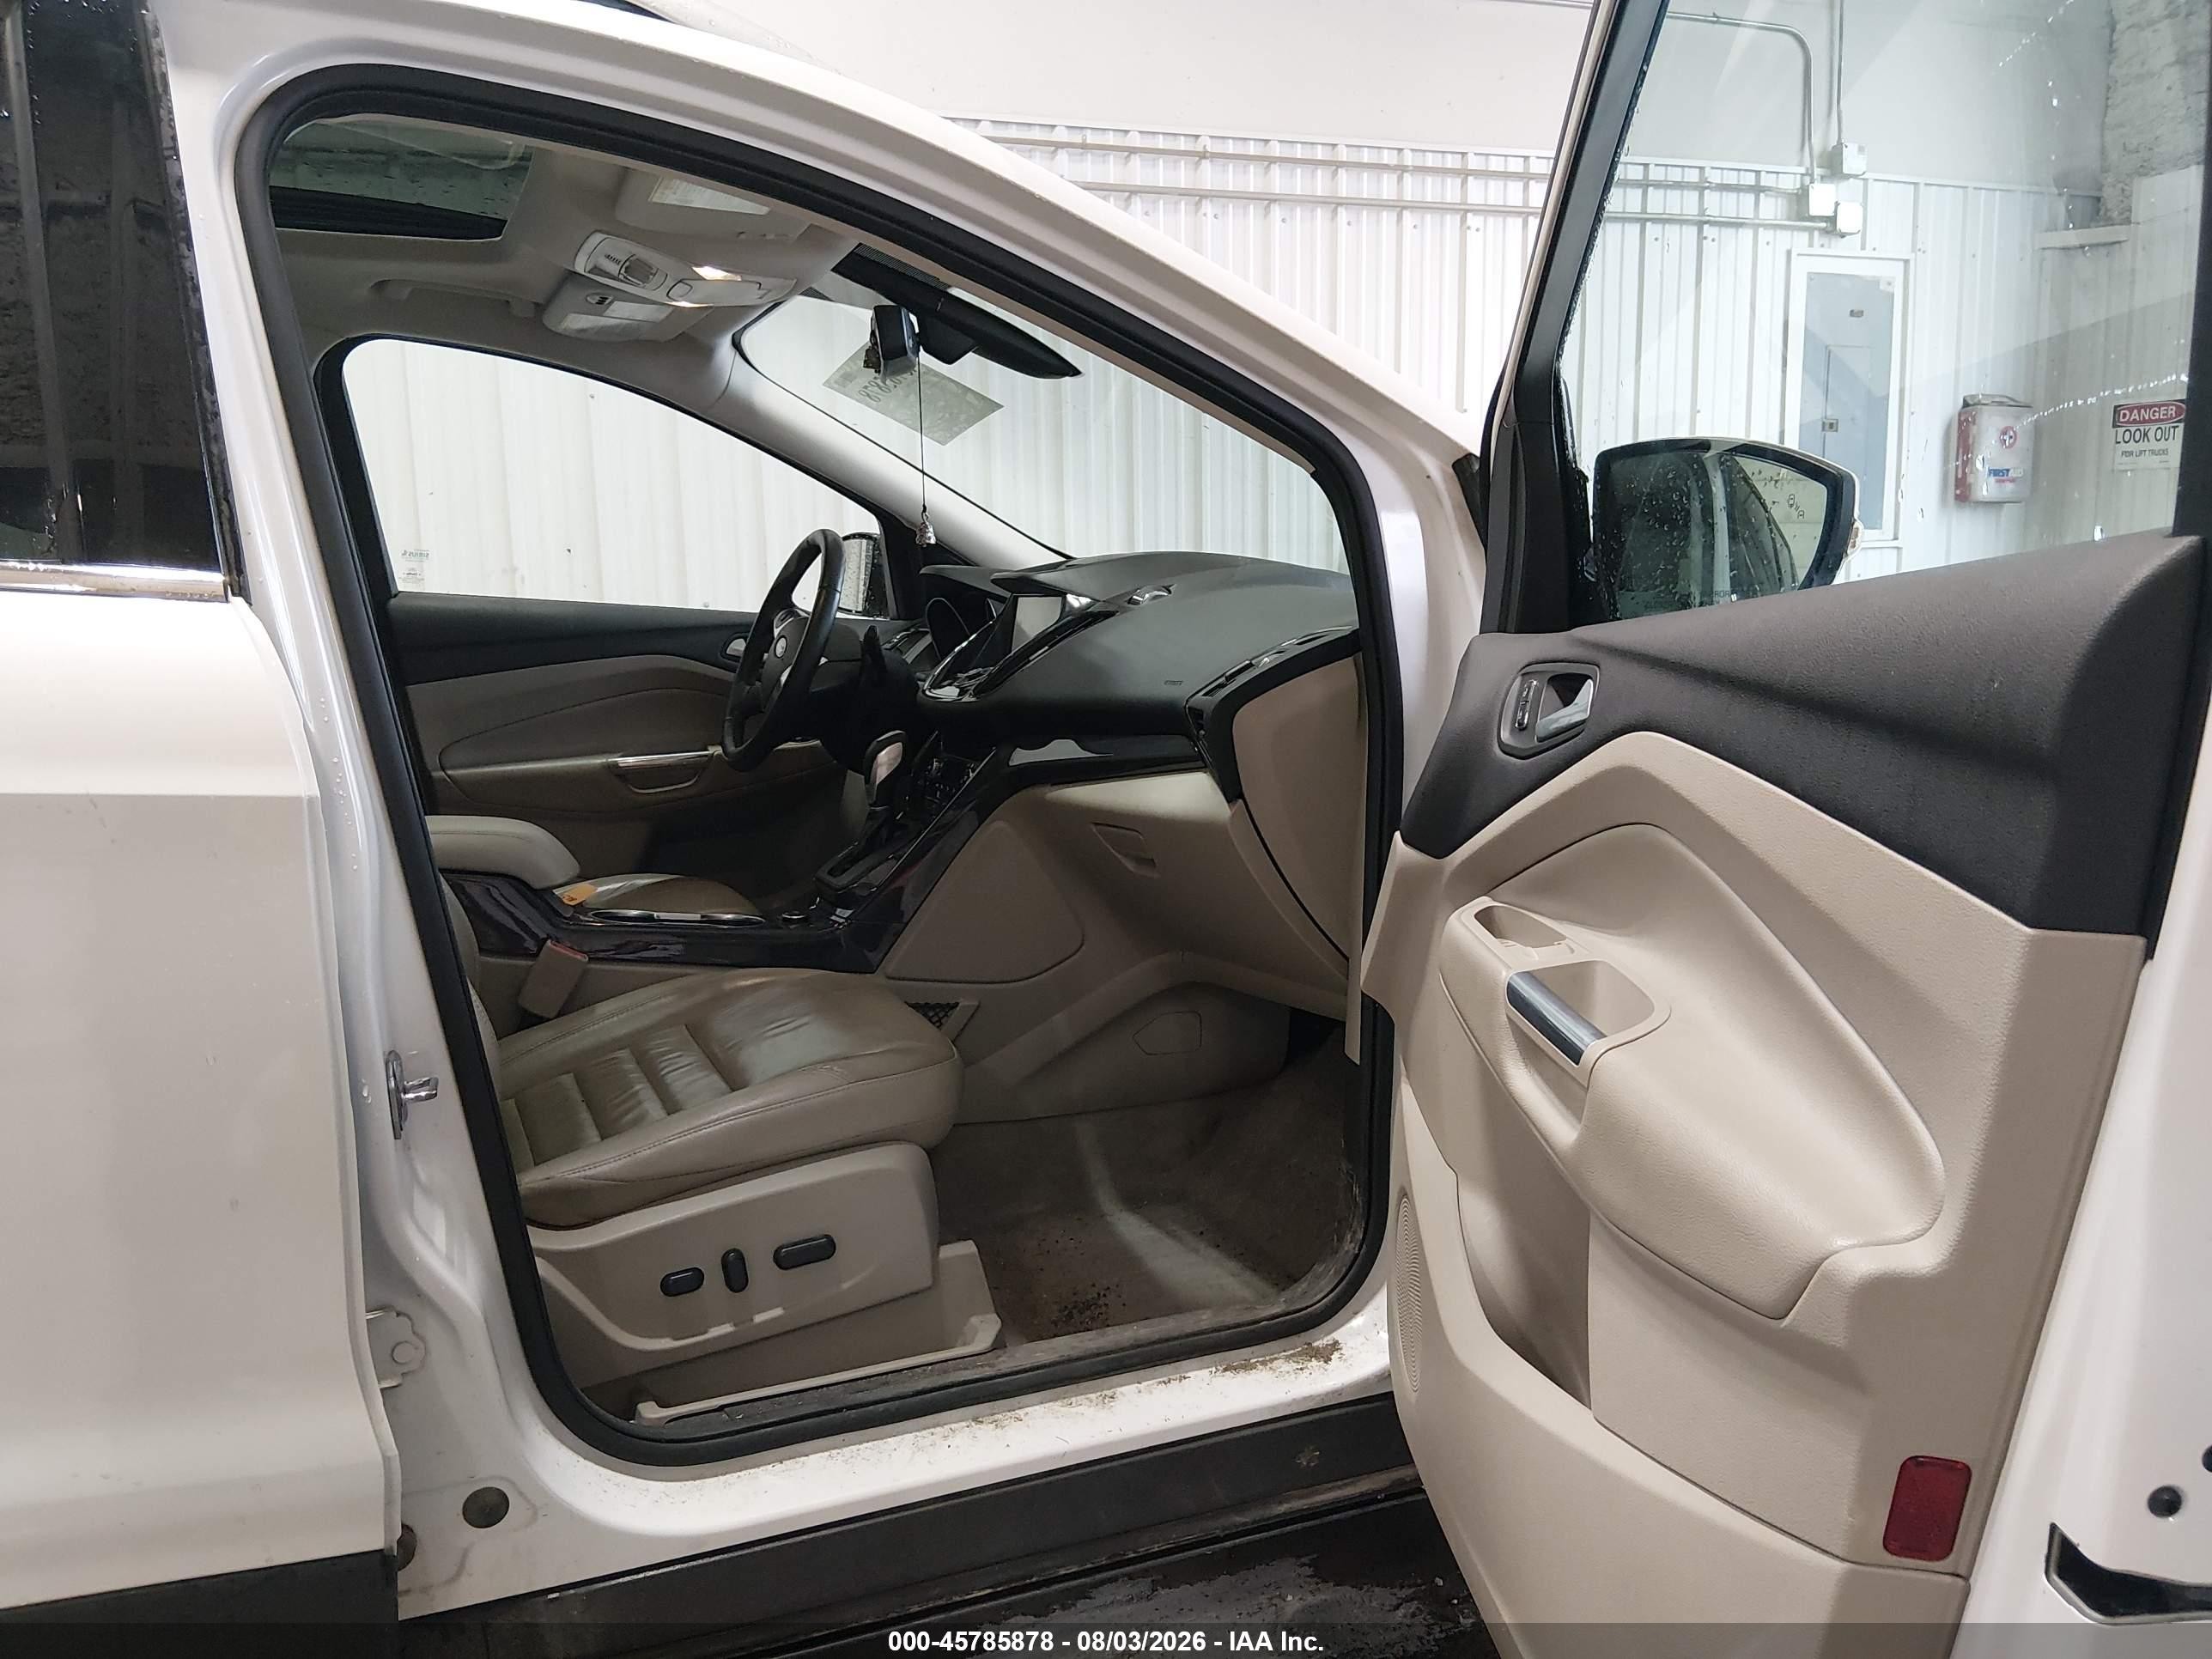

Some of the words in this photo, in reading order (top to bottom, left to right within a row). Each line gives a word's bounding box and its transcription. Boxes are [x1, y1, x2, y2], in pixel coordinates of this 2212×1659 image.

[2119, 405, 2176, 422] DANGER
[2115, 427, 2151, 444] LOOK
[2154, 425, 2179, 442] OUT
[2136, 449, 2147, 458] LIFT
[2148, 448, 2169, 457] TRUCKS
